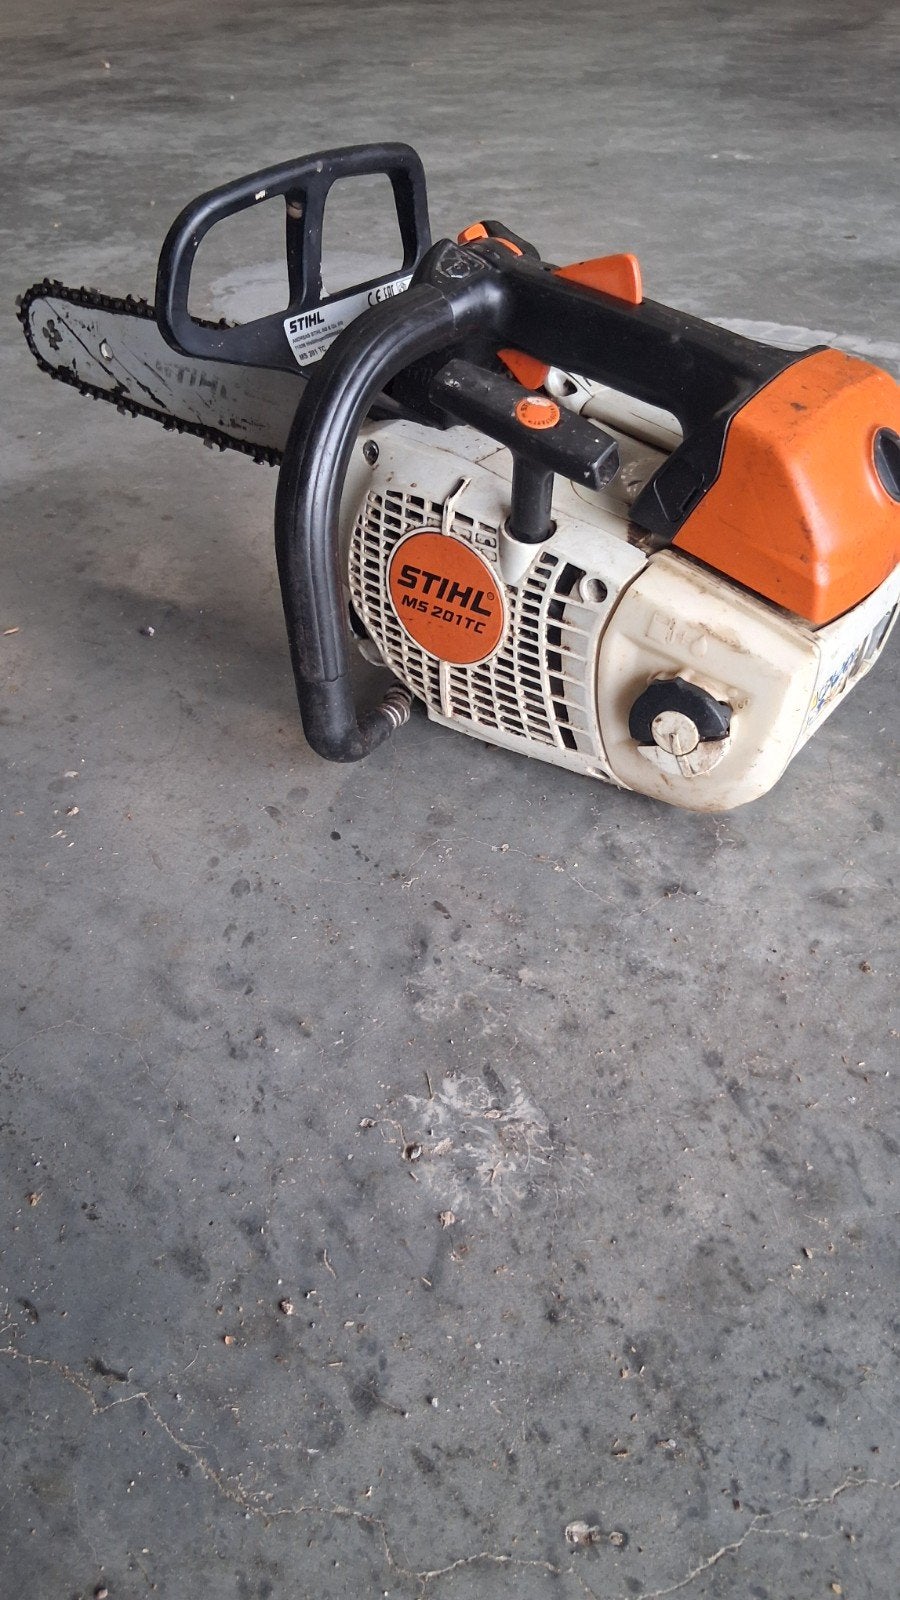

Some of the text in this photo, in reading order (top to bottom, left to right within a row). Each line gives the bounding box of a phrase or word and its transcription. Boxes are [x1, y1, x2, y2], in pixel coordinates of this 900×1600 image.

[289, 311, 325, 334] STIHL
[308, 349, 318, 358] 201
[319, 345, 327, 353] TC
[397, 564, 492, 617] STIHL
[401, 594, 429, 613] MS
